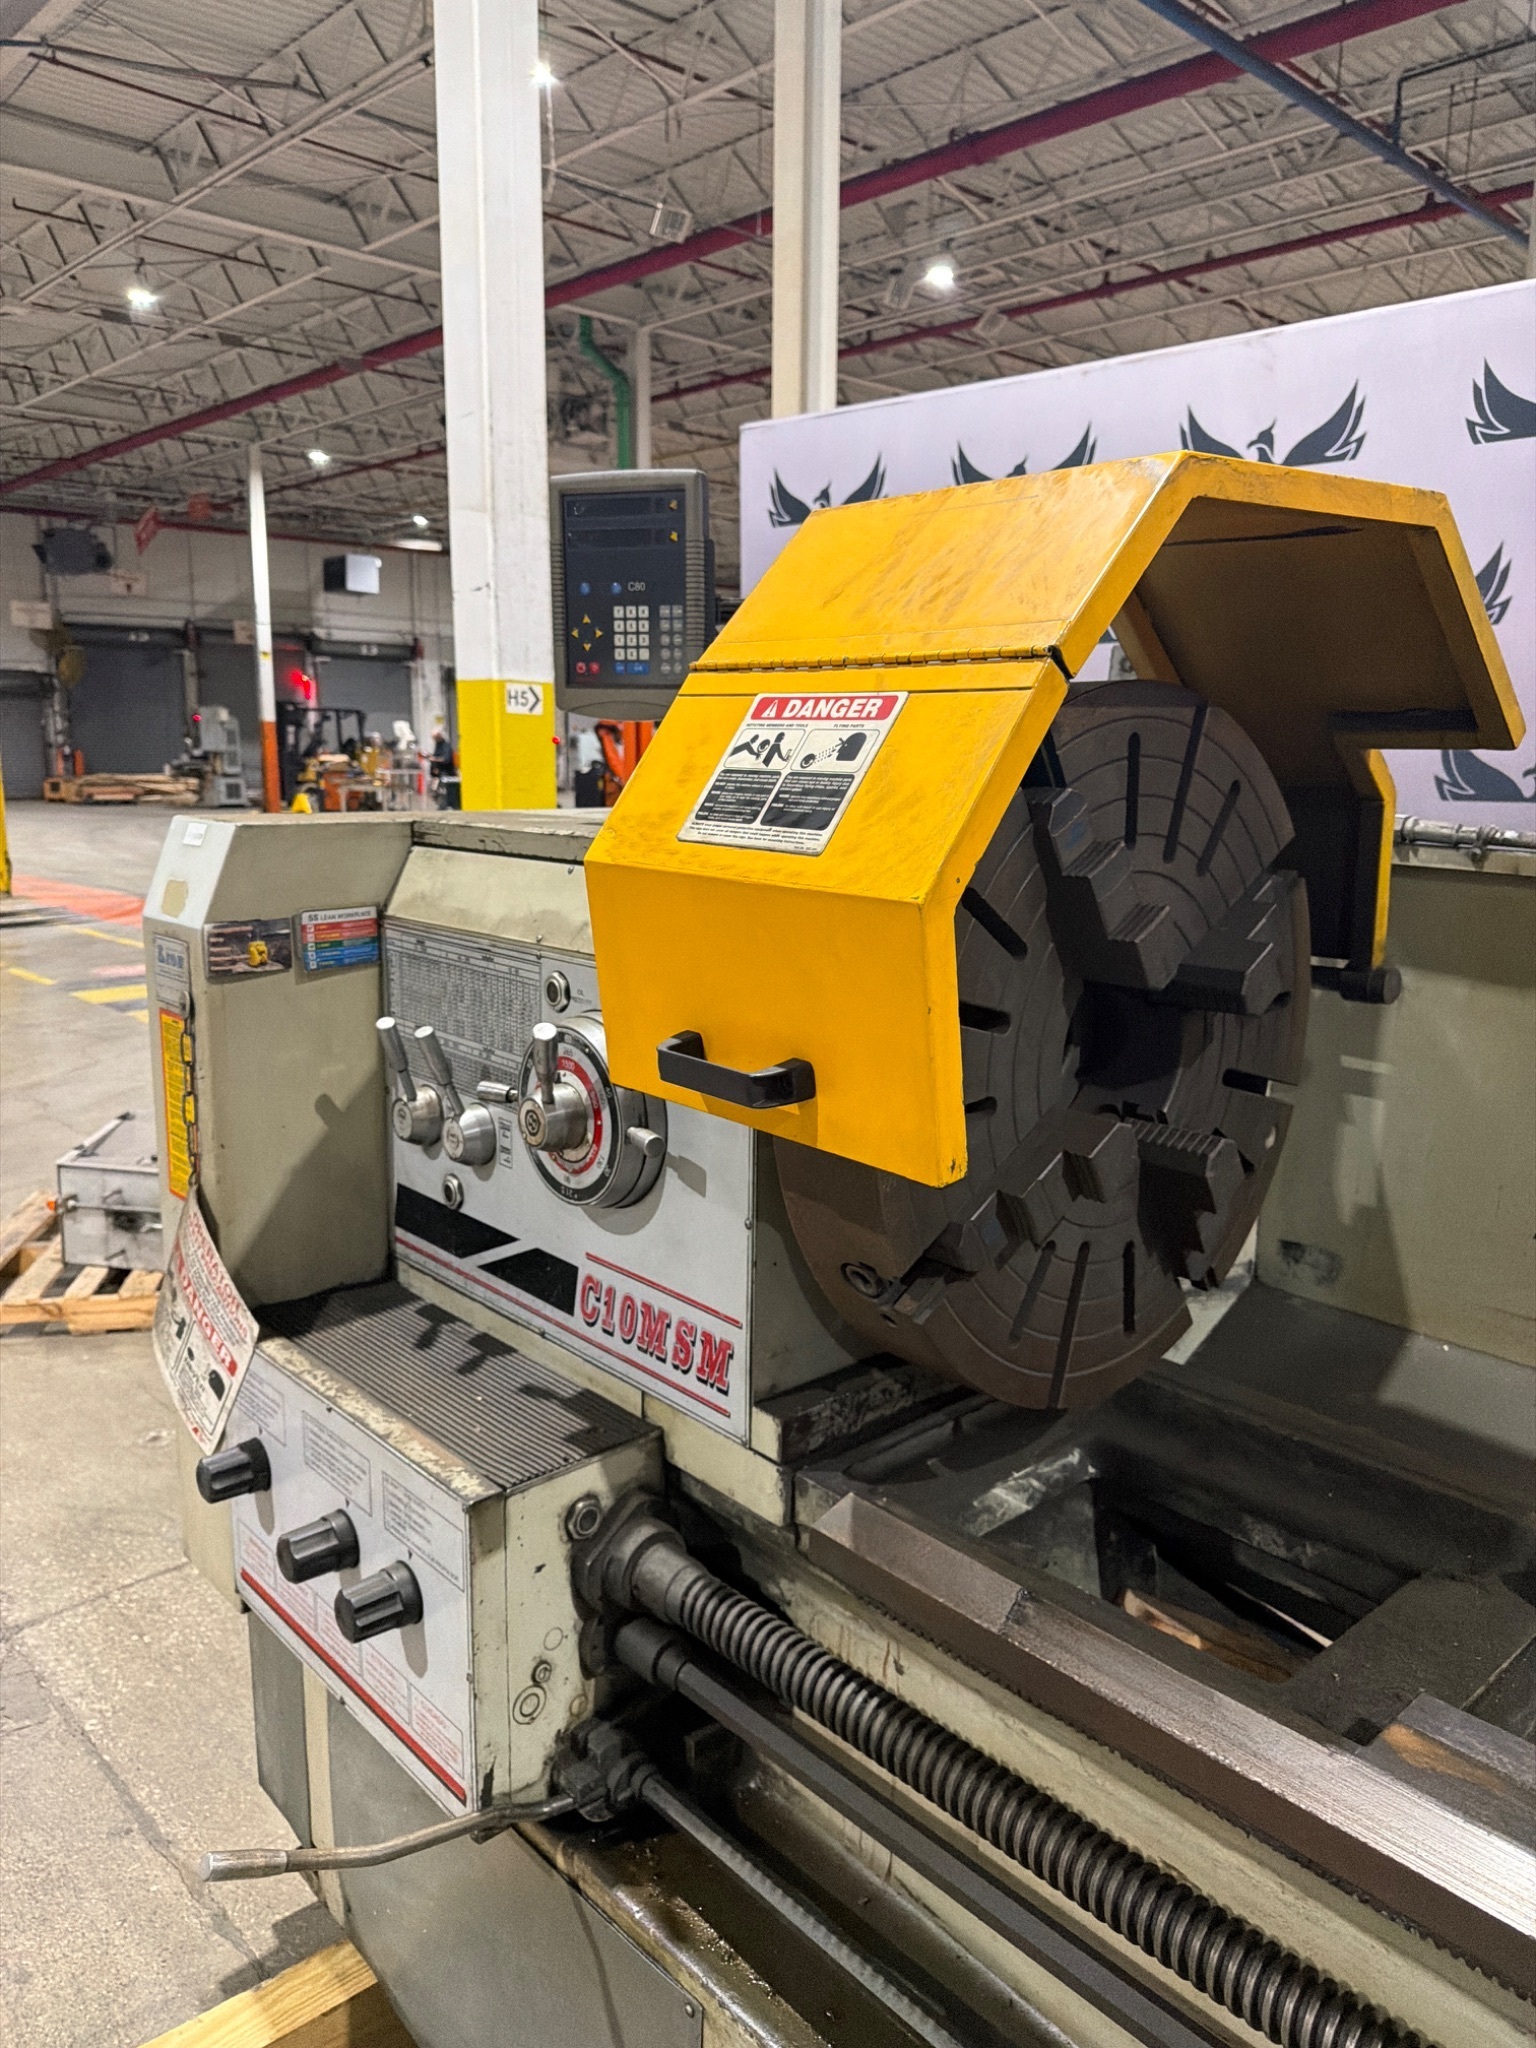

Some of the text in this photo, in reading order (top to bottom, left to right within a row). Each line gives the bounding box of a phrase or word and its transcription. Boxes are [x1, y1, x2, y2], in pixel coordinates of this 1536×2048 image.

[627, 581, 646, 592] C80
[508, 689, 529, 707] H5
[781, 697, 884, 719] DANGER
[182, 1276, 234, 1368] DANGER
[580, 1272, 735, 1397] C10MSM
